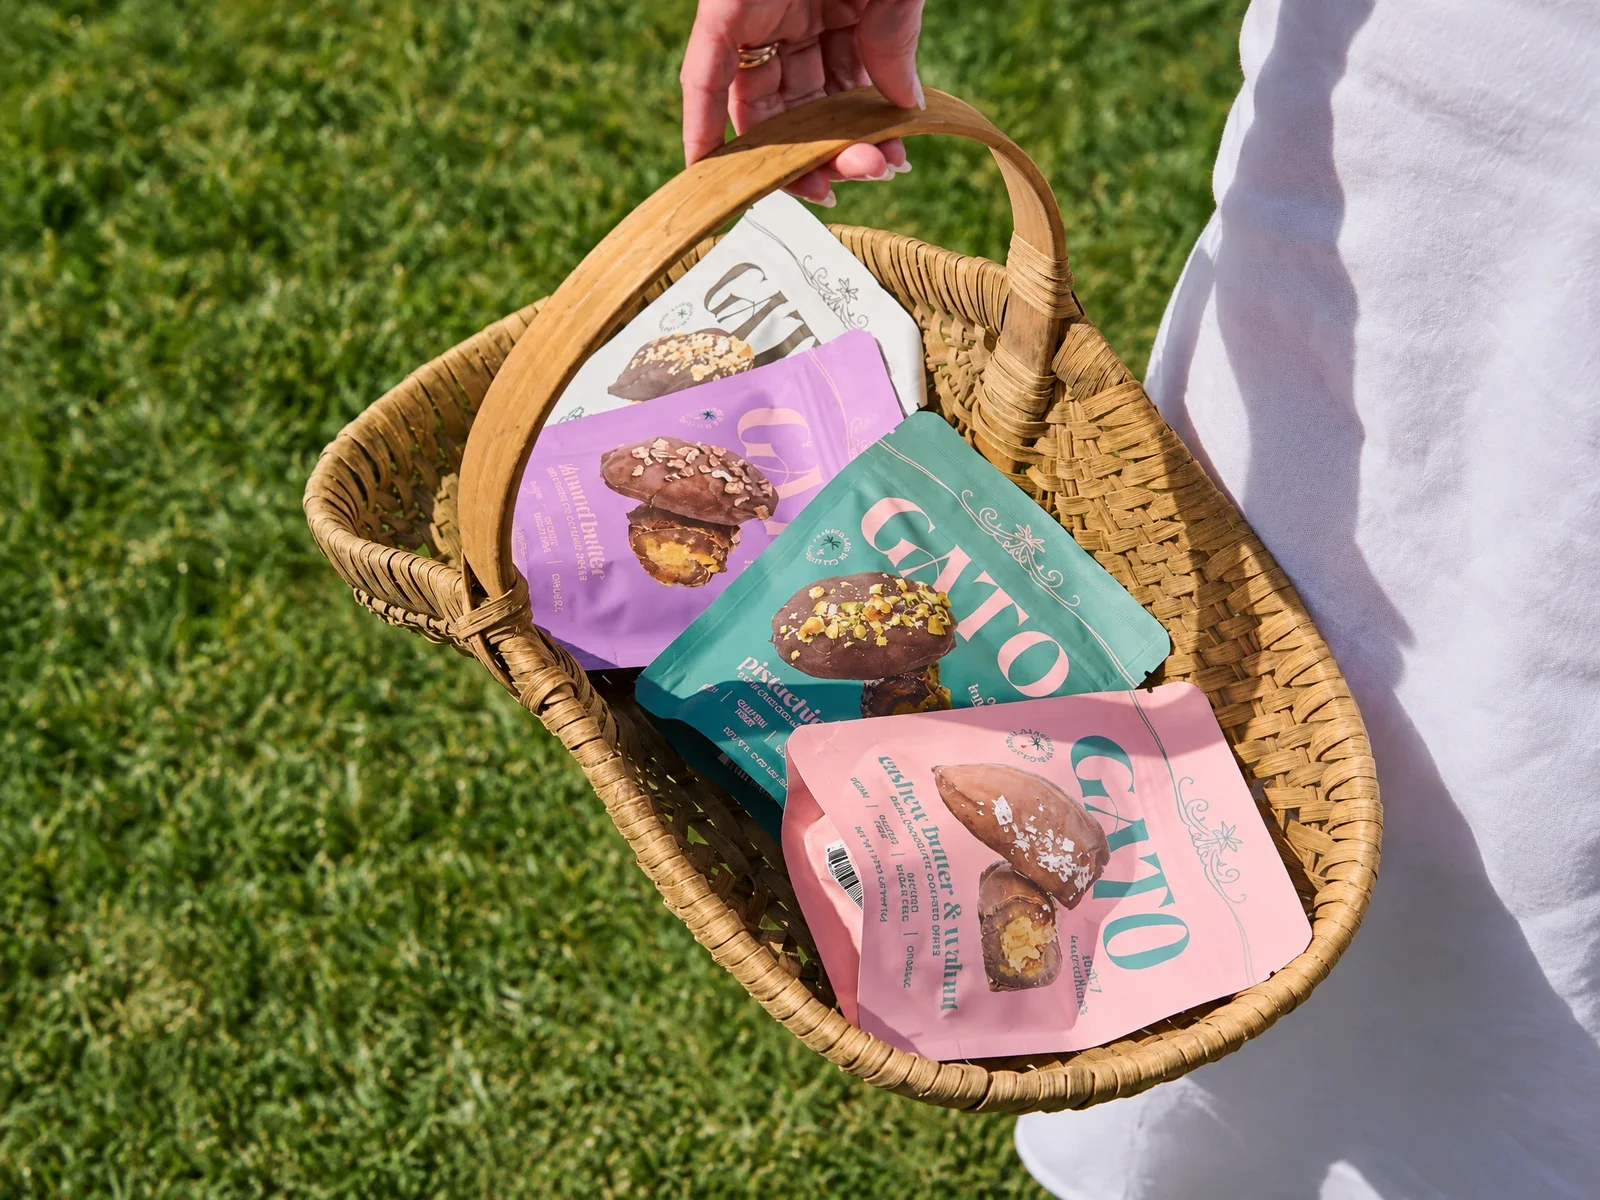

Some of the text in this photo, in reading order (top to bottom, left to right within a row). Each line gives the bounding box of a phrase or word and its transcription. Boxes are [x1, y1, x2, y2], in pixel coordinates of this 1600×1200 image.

[704, 262, 822, 369] GAT
[738, 408, 824, 535] GA
[861, 497, 1070, 697] GATO
[943, 902, 962, 920] &
[1070, 735, 1191, 970] GATO
